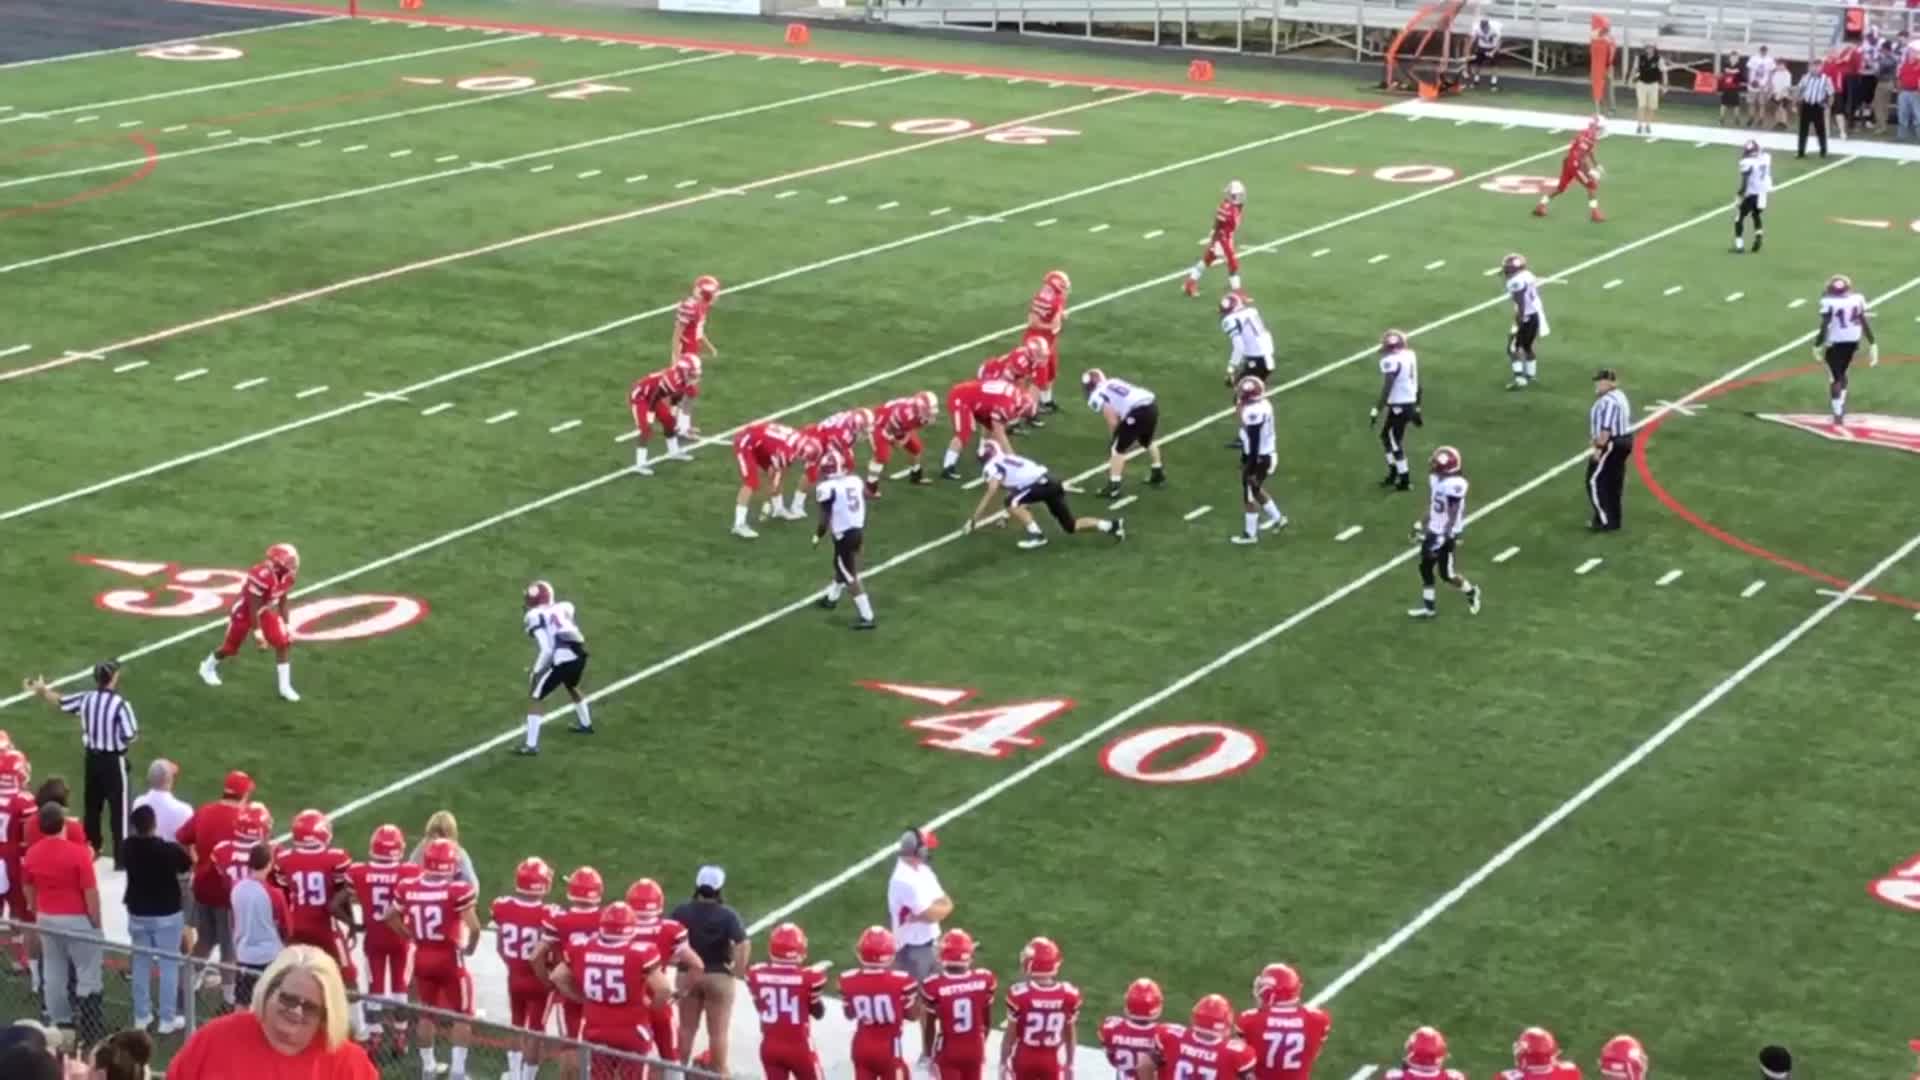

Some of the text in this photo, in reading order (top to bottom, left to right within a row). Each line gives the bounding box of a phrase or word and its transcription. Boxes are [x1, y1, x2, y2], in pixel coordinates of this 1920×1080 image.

[845, 487, 862, 513] 5
[95, 567, 430, 642] 30
[903, 697, 1268, 783] 40
[291, 870, 327, 906] 19
[371, 886, 392, 921] 5
[409, 904, 446, 941] 12
[583, 966, 628, 1004] 65
[760, 986, 801, 1025] 34
[952, 997, 973, 1033] 9
[1023, 1011, 1067, 1046] 29
[1261, 1031, 1306, 1070] 72
